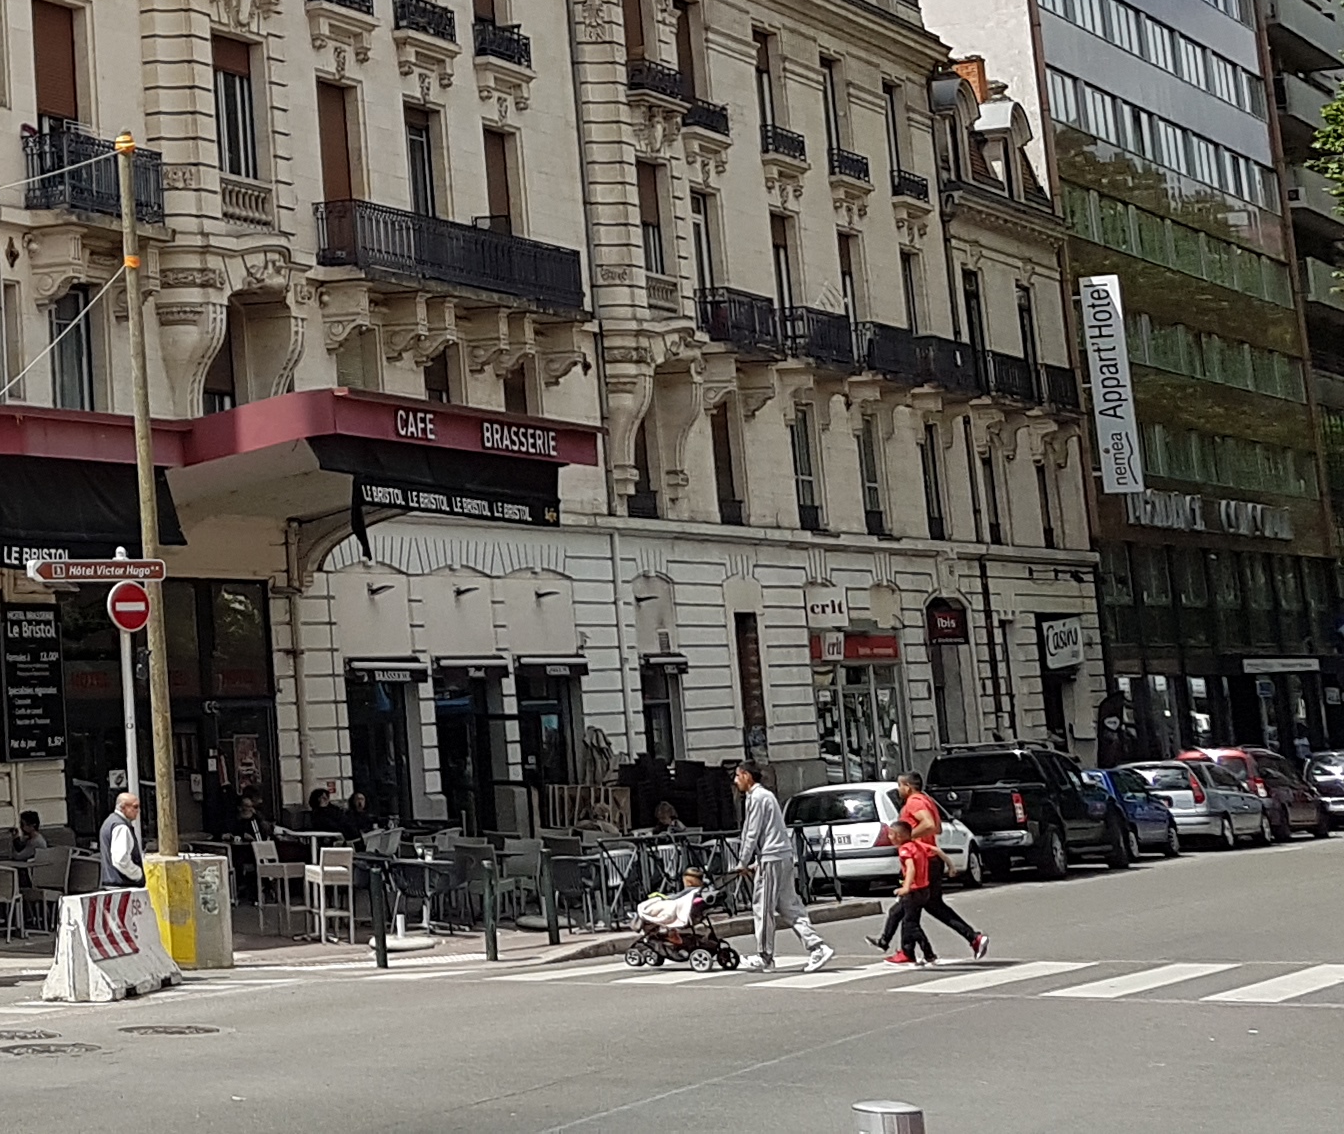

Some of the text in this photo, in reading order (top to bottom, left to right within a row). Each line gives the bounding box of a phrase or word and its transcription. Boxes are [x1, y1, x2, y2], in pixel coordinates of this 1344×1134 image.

[1088, 282, 1127, 419] Appart'Hotel
[397, 409, 558, 456] CAFE BRASSERIE
[362, 484, 532, 521] LE BRISTOL LE BRISTOL LE BRISTOL LE BRISTOL
[4, 546, 20, 564] LE
[69, 565, 94, 576] Hôtel
[97, 565, 124, 575] Victor
[7, 621, 56, 639] Le Bristol
[937, 617, 956, 629] ibis
